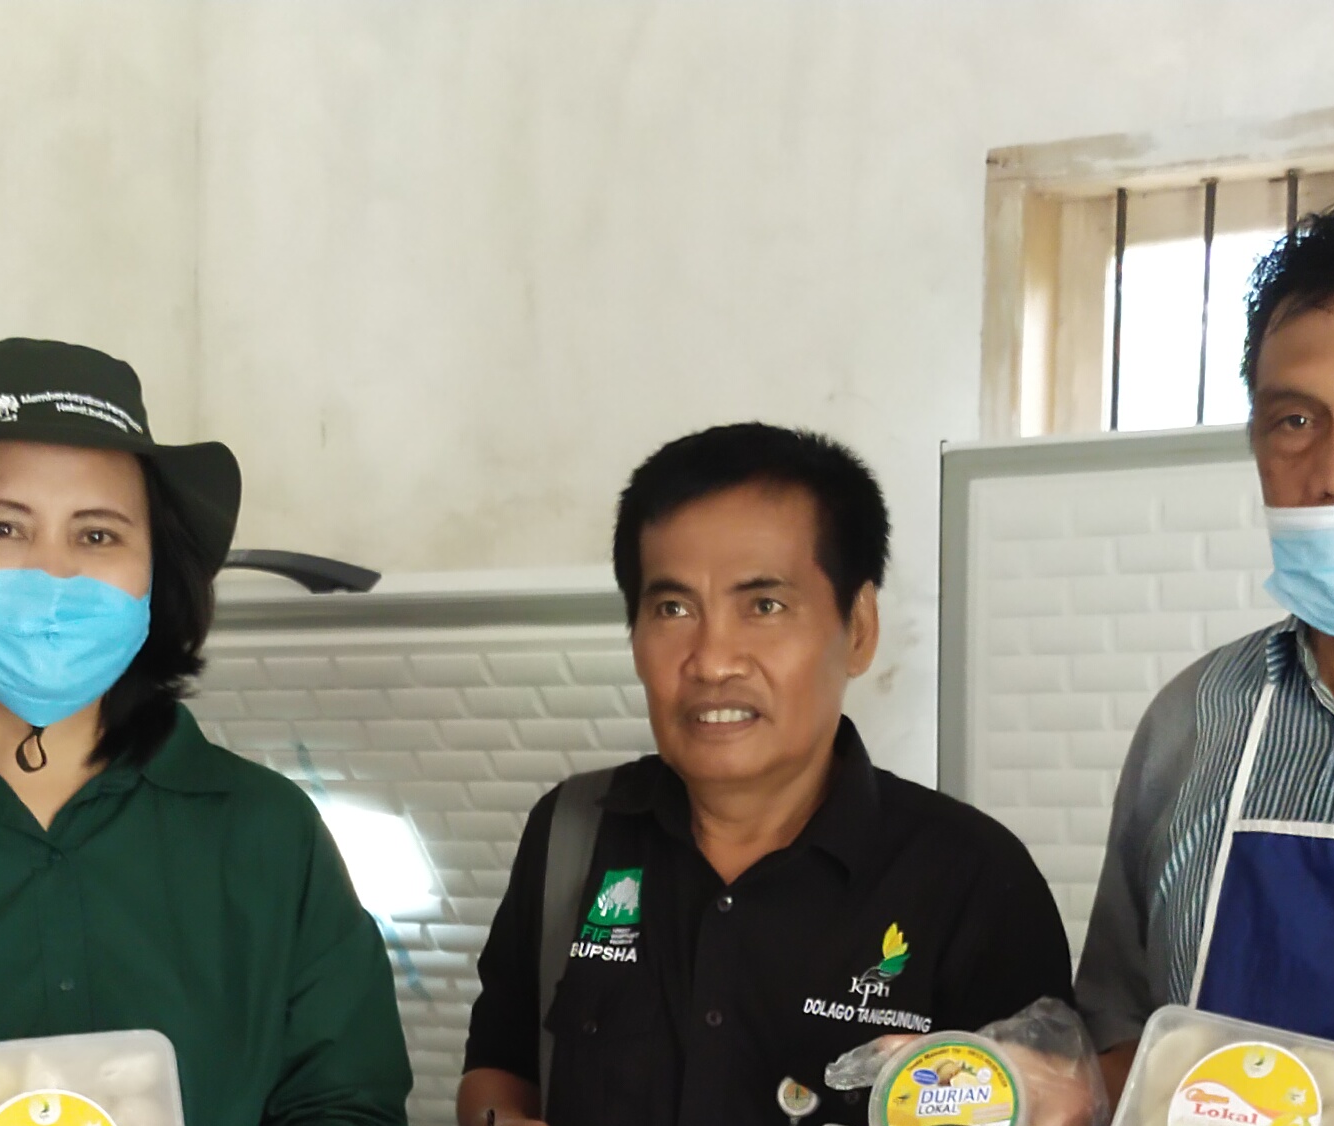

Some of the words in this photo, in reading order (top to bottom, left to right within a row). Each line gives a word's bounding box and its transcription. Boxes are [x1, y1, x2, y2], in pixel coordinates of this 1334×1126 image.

[803, 998, 855, 1022] DOLAGO
[857, 1007, 932, 1033] TANGGUNUNG
[920, 1087, 990, 1104] DURIAN
[918, 1103, 959, 1115] LOKAL
[1193, 1103, 1258, 1125] Lokal
